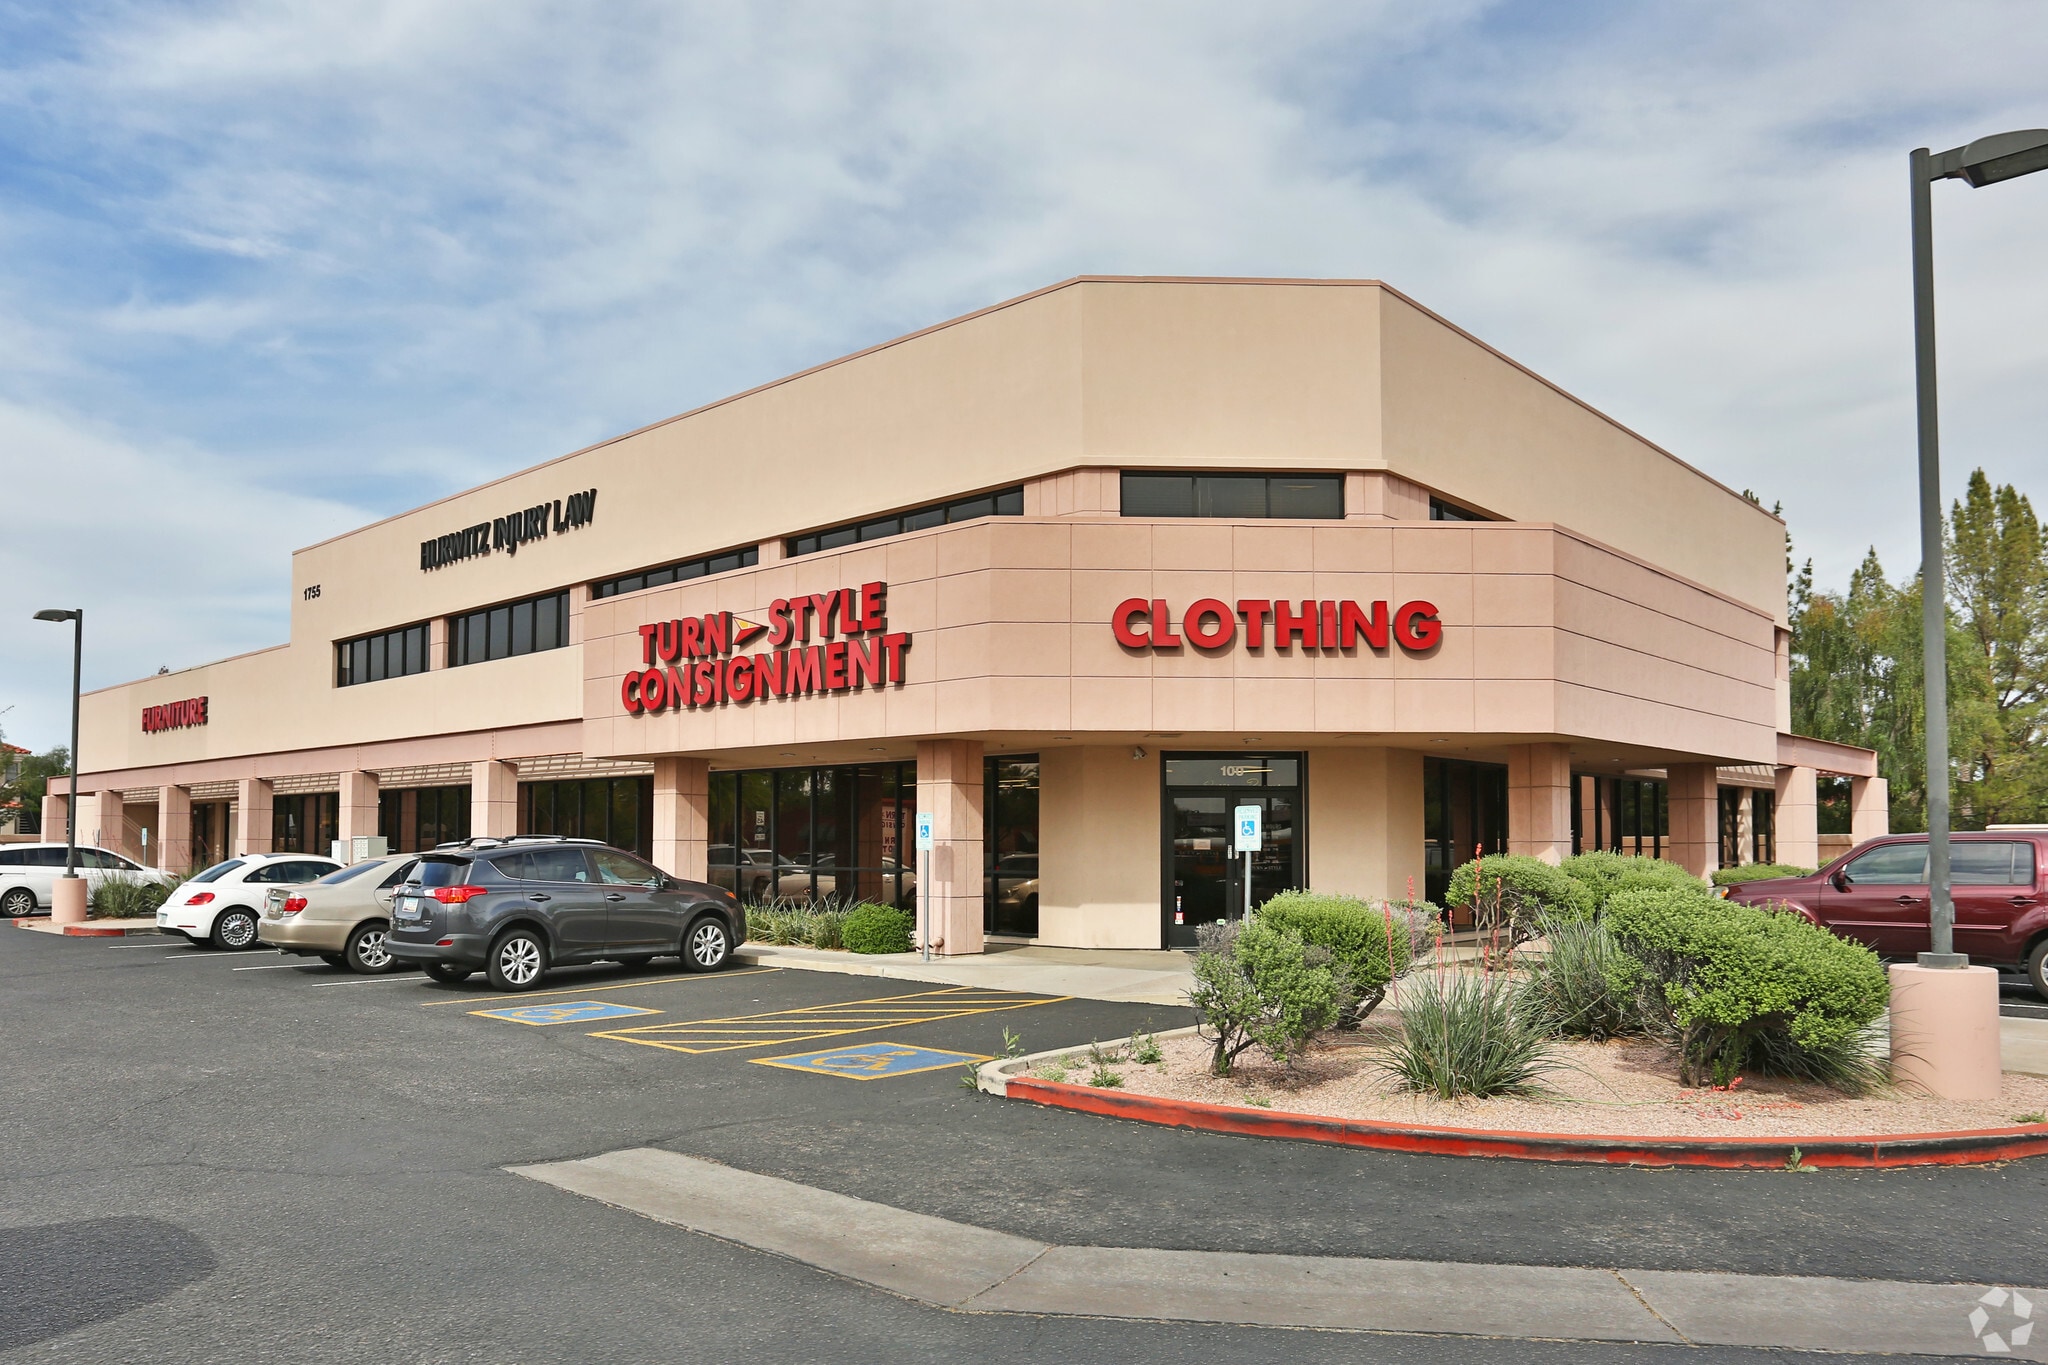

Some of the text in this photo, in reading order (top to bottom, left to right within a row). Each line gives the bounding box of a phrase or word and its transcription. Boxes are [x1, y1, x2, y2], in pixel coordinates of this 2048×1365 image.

[420, 488, 597, 571] HURWITZ INJURY LAW
[304, 584, 321, 600] 1755
[639, 581, 887, 665] TURN STYLE
[1112, 598, 1442, 650] CLOTHING
[621, 632, 912, 713] CONSIGNMENT
[142, 696, 208, 733] FURNITURE
